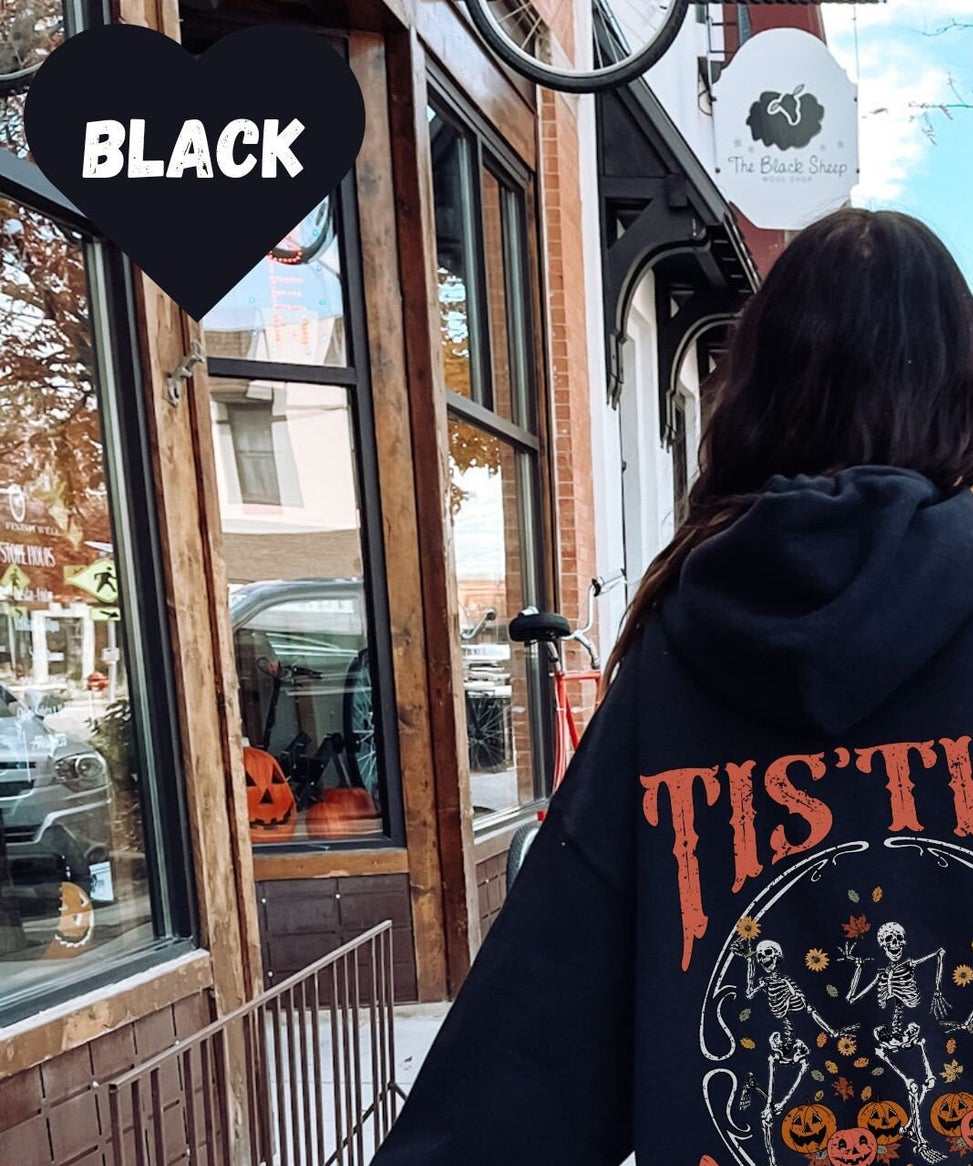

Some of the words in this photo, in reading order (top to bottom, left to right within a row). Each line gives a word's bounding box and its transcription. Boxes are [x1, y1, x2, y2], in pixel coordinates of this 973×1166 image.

[727, 156, 755, 173] The
[760, 155, 803, 174] Black
[808, 154, 848, 177] Sheep
